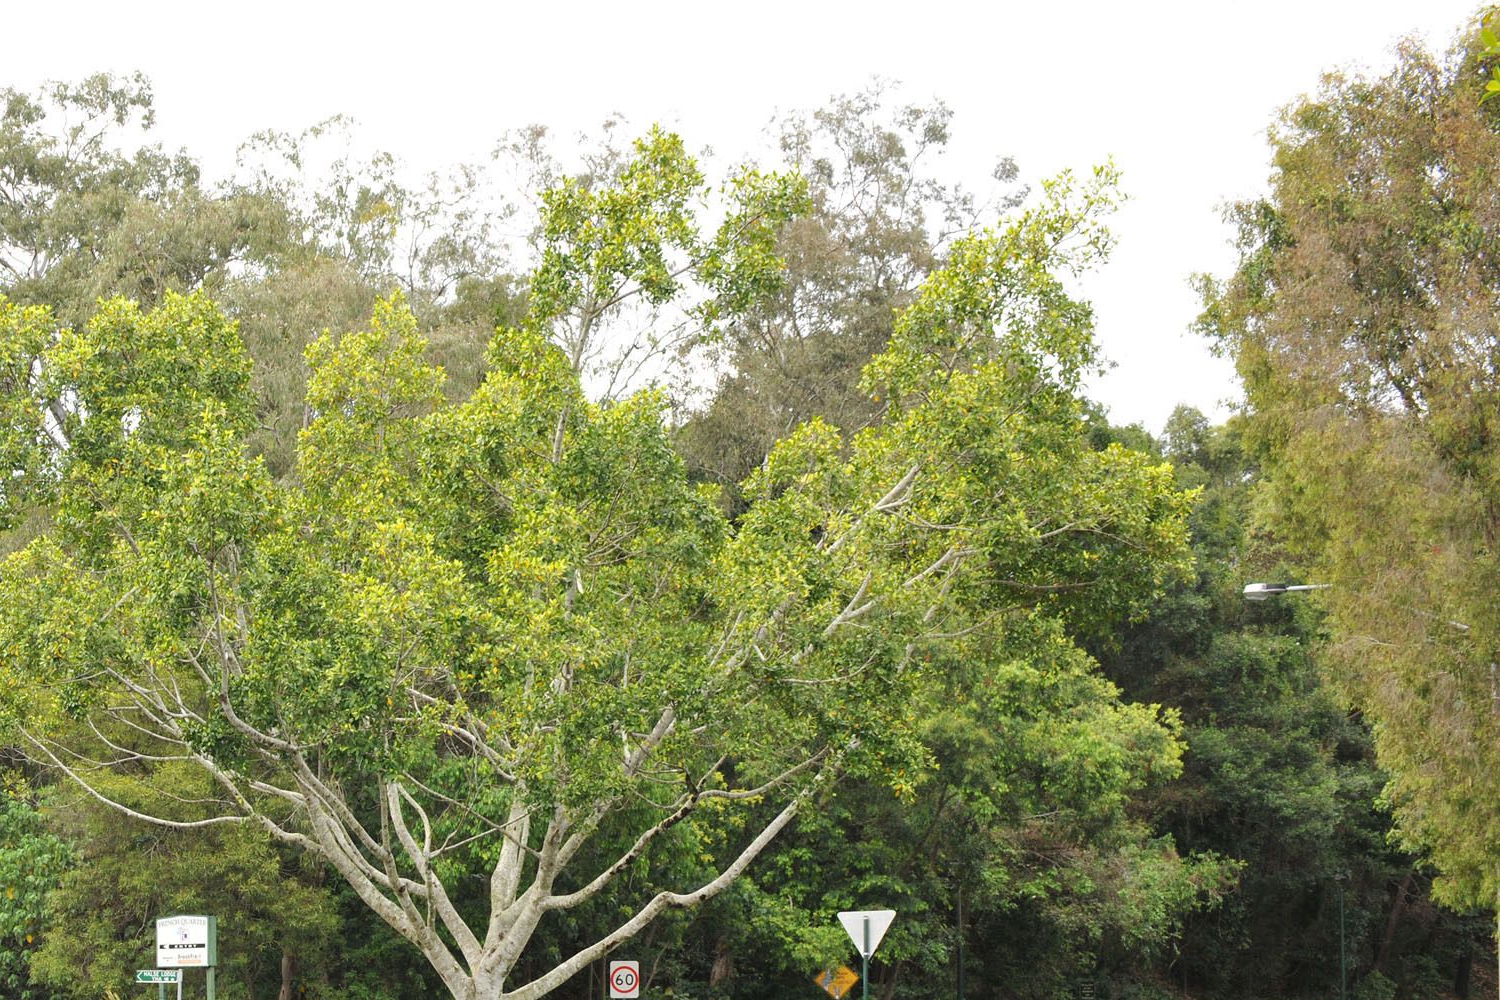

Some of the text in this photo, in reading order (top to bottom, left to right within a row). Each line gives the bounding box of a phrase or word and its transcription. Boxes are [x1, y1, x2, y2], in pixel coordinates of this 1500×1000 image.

[158, 918, 206, 928] FRENCH QUARTER
[615, 974, 634, 986] 60
